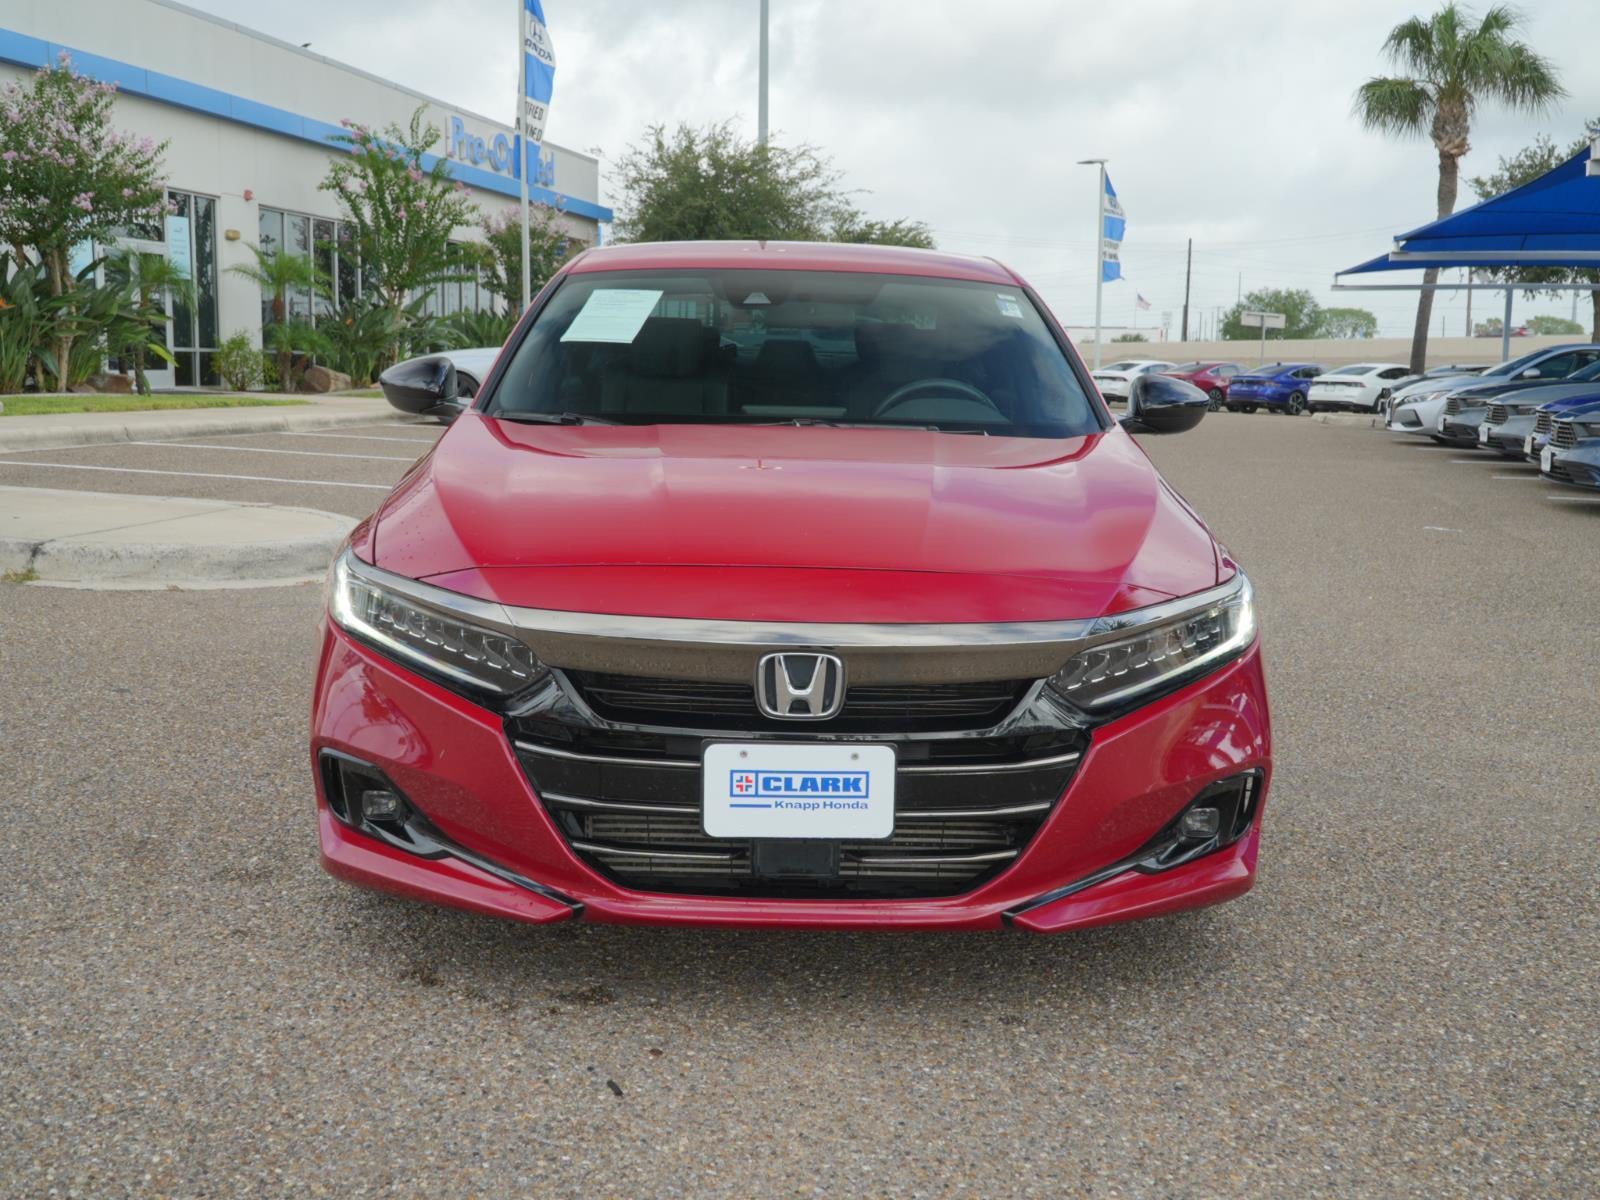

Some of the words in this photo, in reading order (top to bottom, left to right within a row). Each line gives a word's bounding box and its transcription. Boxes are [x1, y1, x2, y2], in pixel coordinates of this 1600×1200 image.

[525, 38, 552, 62] ONDA
[762, 776, 862, 792] CLARK
[775, 801, 820, 811] Knapp
[823, 801, 868, 810] Honda
